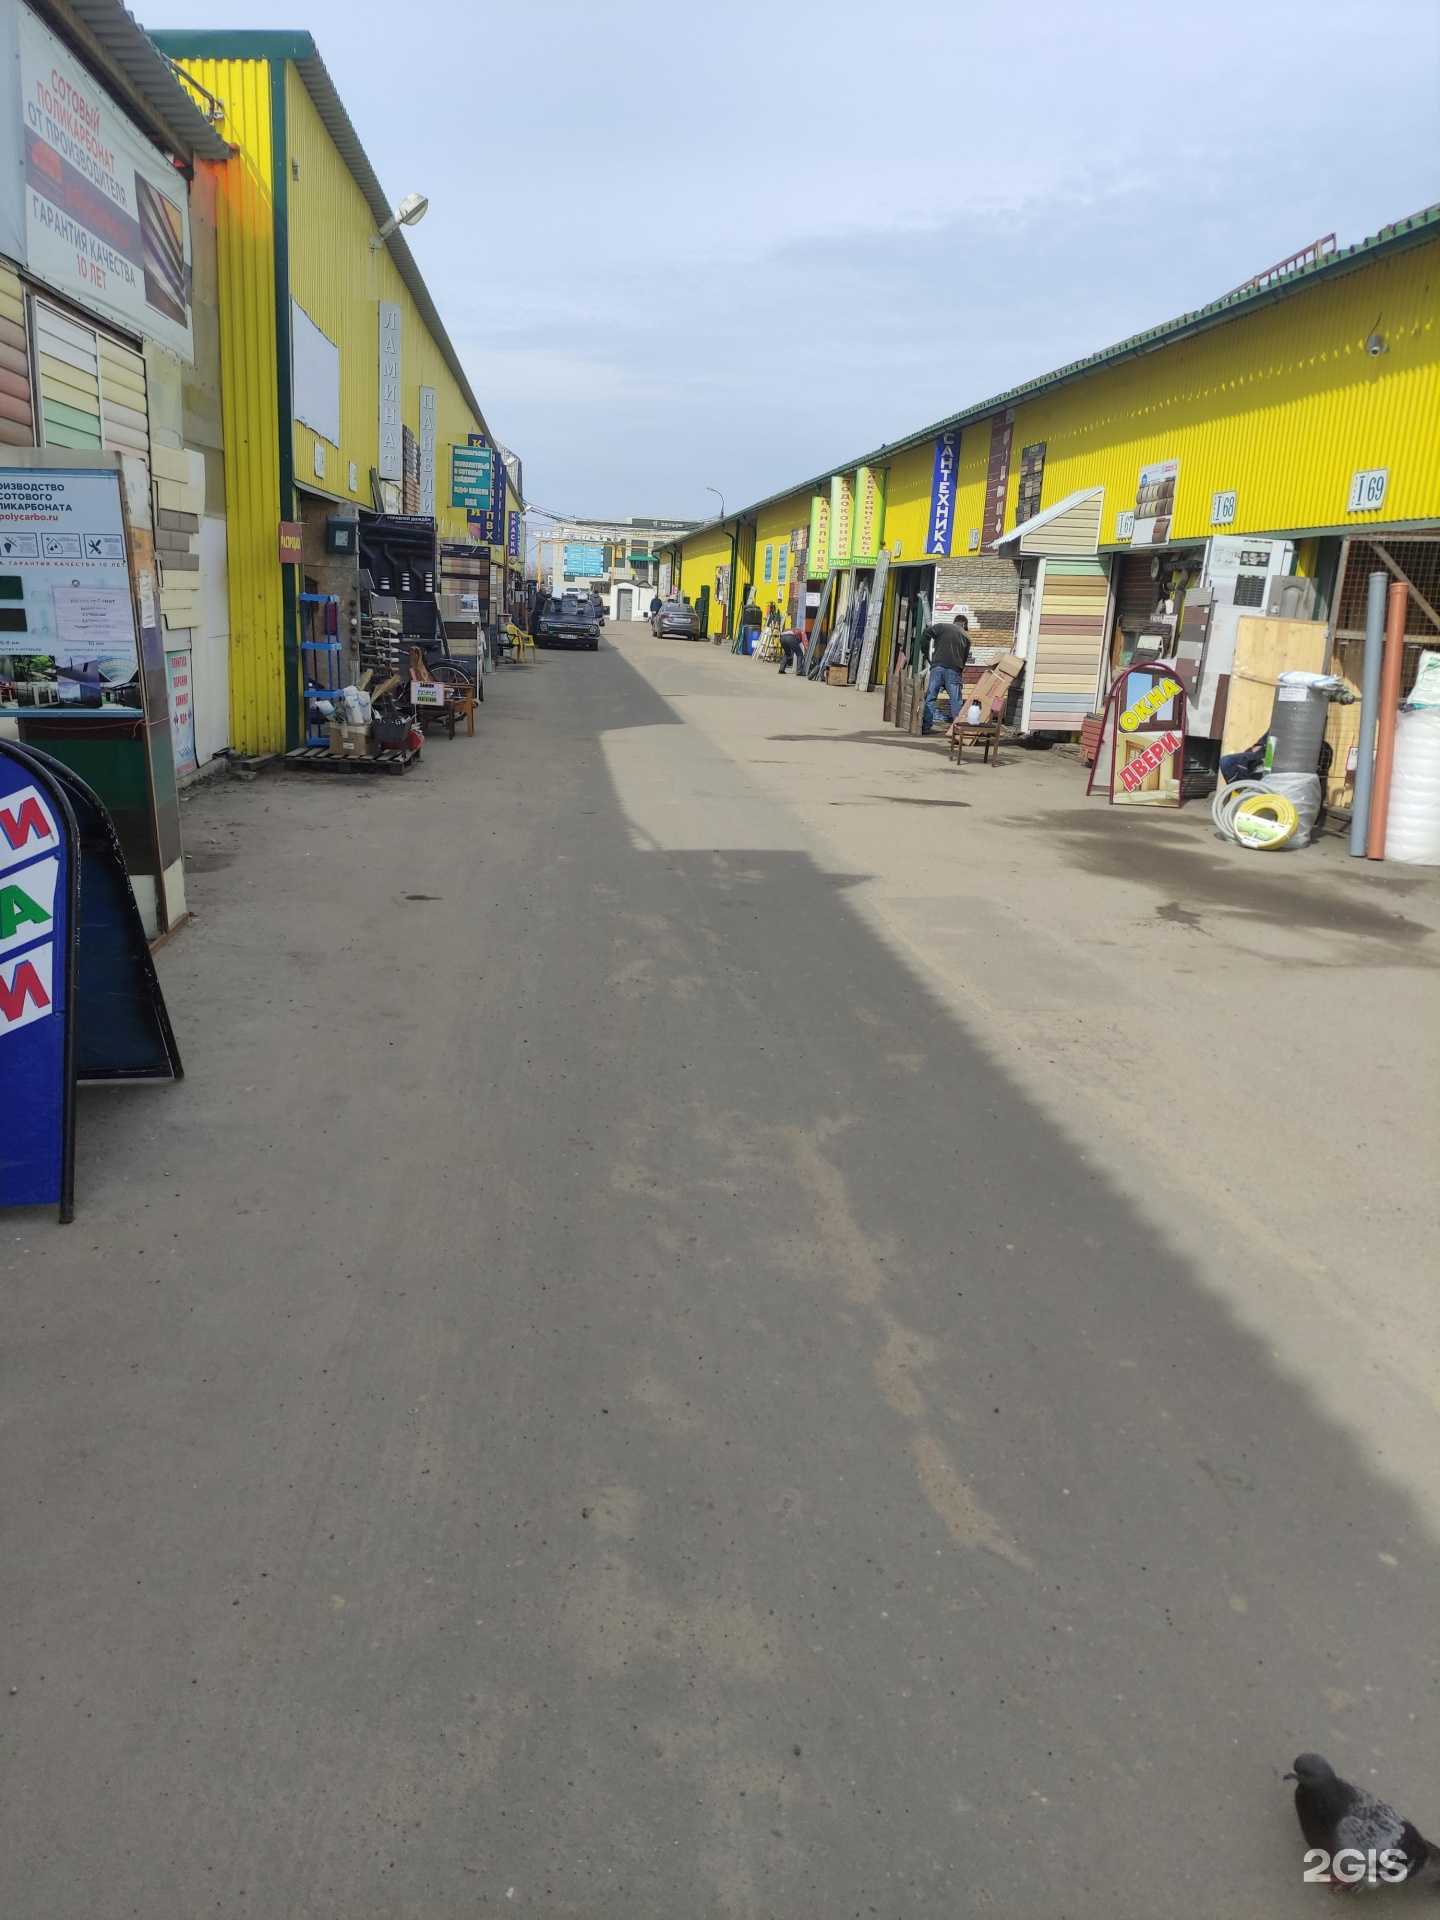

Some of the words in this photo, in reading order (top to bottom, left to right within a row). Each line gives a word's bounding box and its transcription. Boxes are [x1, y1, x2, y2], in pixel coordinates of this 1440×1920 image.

[36, 80, 114, 174] ПОЛИКАРБОНАТ
[51, 69, 100, 136] СОТОВЫЙ
[28, 101, 42, 132] ОТ
[46, 116, 127, 208] ПРОИЗВОДИТЕЛЯ
[33, 195, 88, 251] ГАРАНТИЯ
[90, 239, 136, 288] КАЧЕСТВА
[77, 254, 87, 279] 10
[90, 263, 107, 290] ЛЕТ
[486, 511, 494, 540] ПВХ
[933, 432, 955, 554] САНТЕХНИКА
[1120, 678, 1183, 732] ОКНА
[1120, 730, 1182, 793] ДВЕРИ
